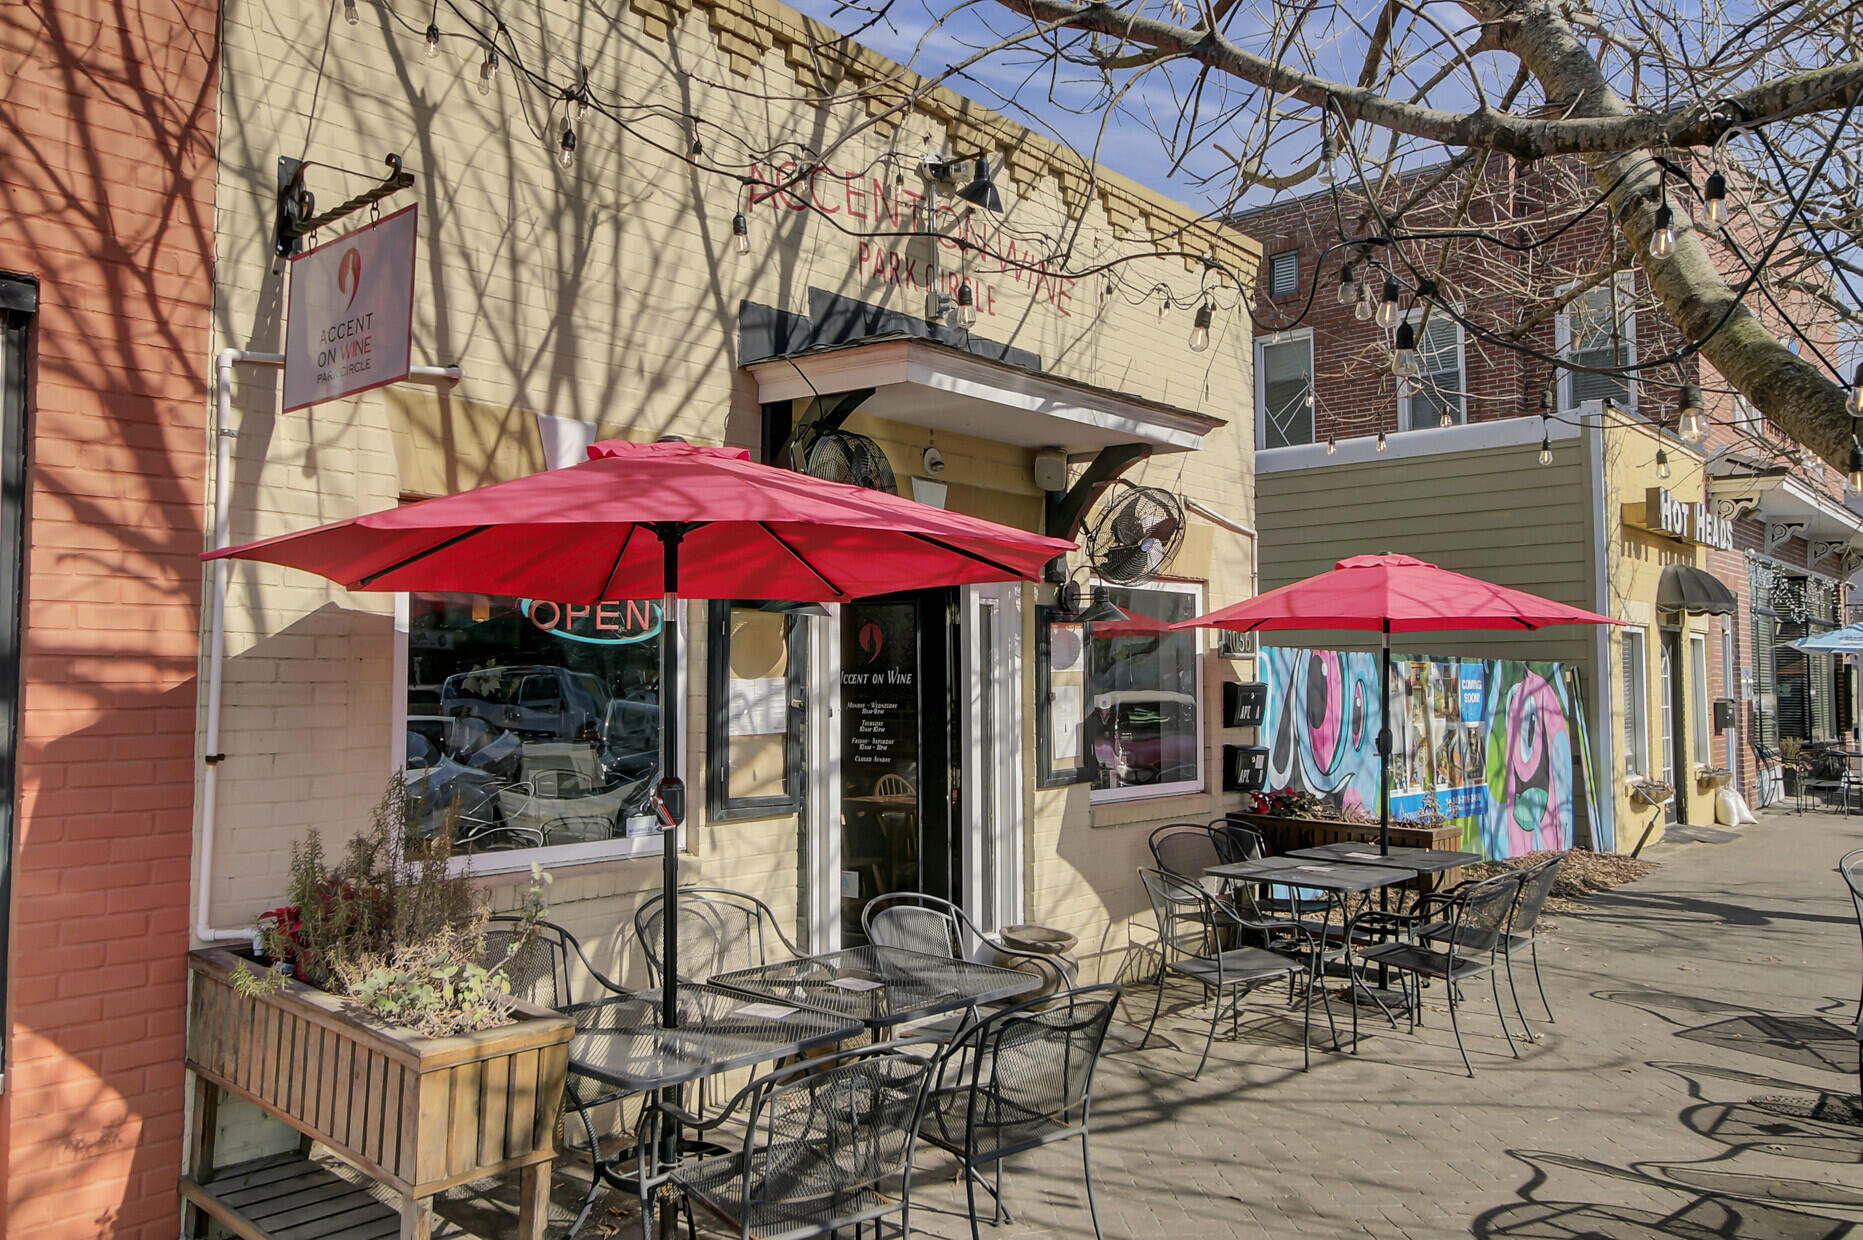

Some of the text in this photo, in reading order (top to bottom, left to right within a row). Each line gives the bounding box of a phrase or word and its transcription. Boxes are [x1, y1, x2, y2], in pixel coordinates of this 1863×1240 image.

[749, 161, 1075, 317] ACCENT ON WINE
[858, 241, 918, 292] PARK
[320, 312, 374, 344] ACCENT
[317, 336, 372, 368] ON WINE
[316, 358, 372, 384] PAR CIRCLE
[1660, 487, 1734, 552] HOT HEADS
[529, 600, 650, 630] OPEN
[1461, 679, 1482, 690] COMING
[1464, 692, 1481, 703] SOON!
[1255, 704, 1261, 720] A
